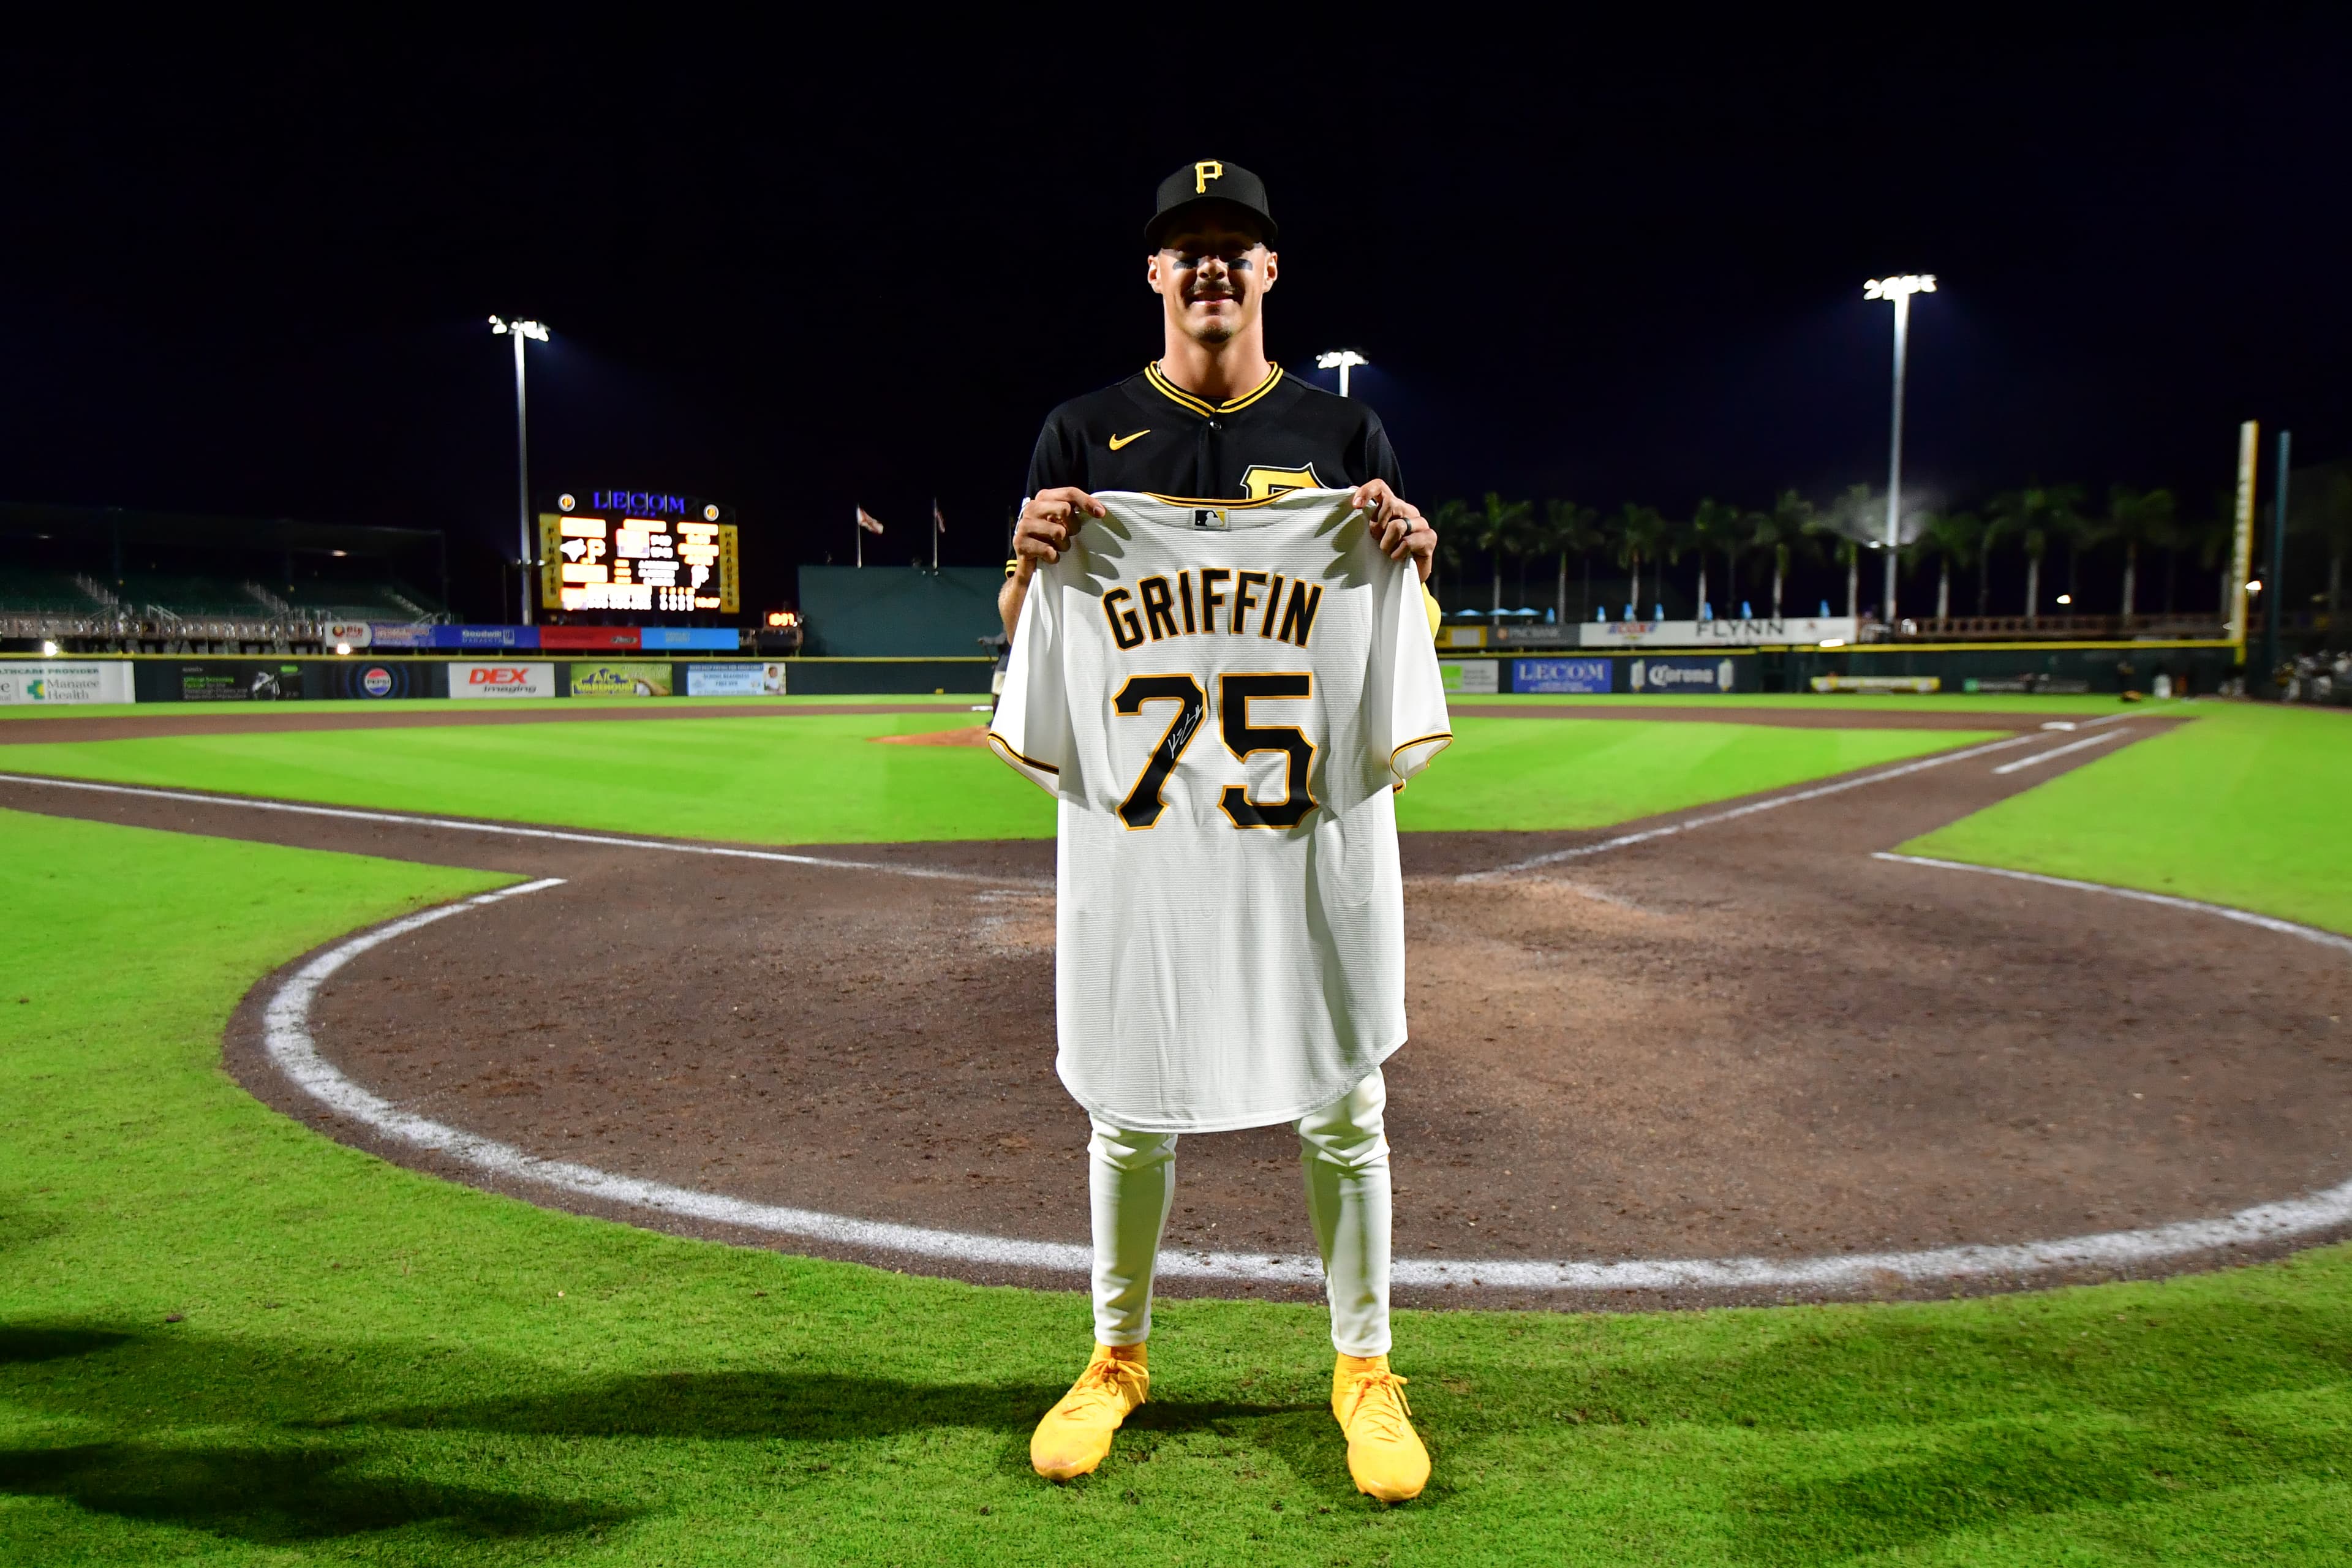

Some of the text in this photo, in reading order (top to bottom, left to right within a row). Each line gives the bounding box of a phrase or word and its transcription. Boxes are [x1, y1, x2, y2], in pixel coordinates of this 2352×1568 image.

[1195, 160, 1223, 194] P
[593, 491, 685, 514] LECOM
[1102, 568, 1324, 652] GRIFFIN
[1696, 620, 1785, 637] FLYNN
[469, 668, 529, 684] DEX
[1519, 663, 1604, 681] LECOM
[1649, 665, 1714, 687] Corona
[48, 679, 100, 688] Manatee
[48, 690, 89, 700] Health
[1111, 672, 1319, 831] 75
